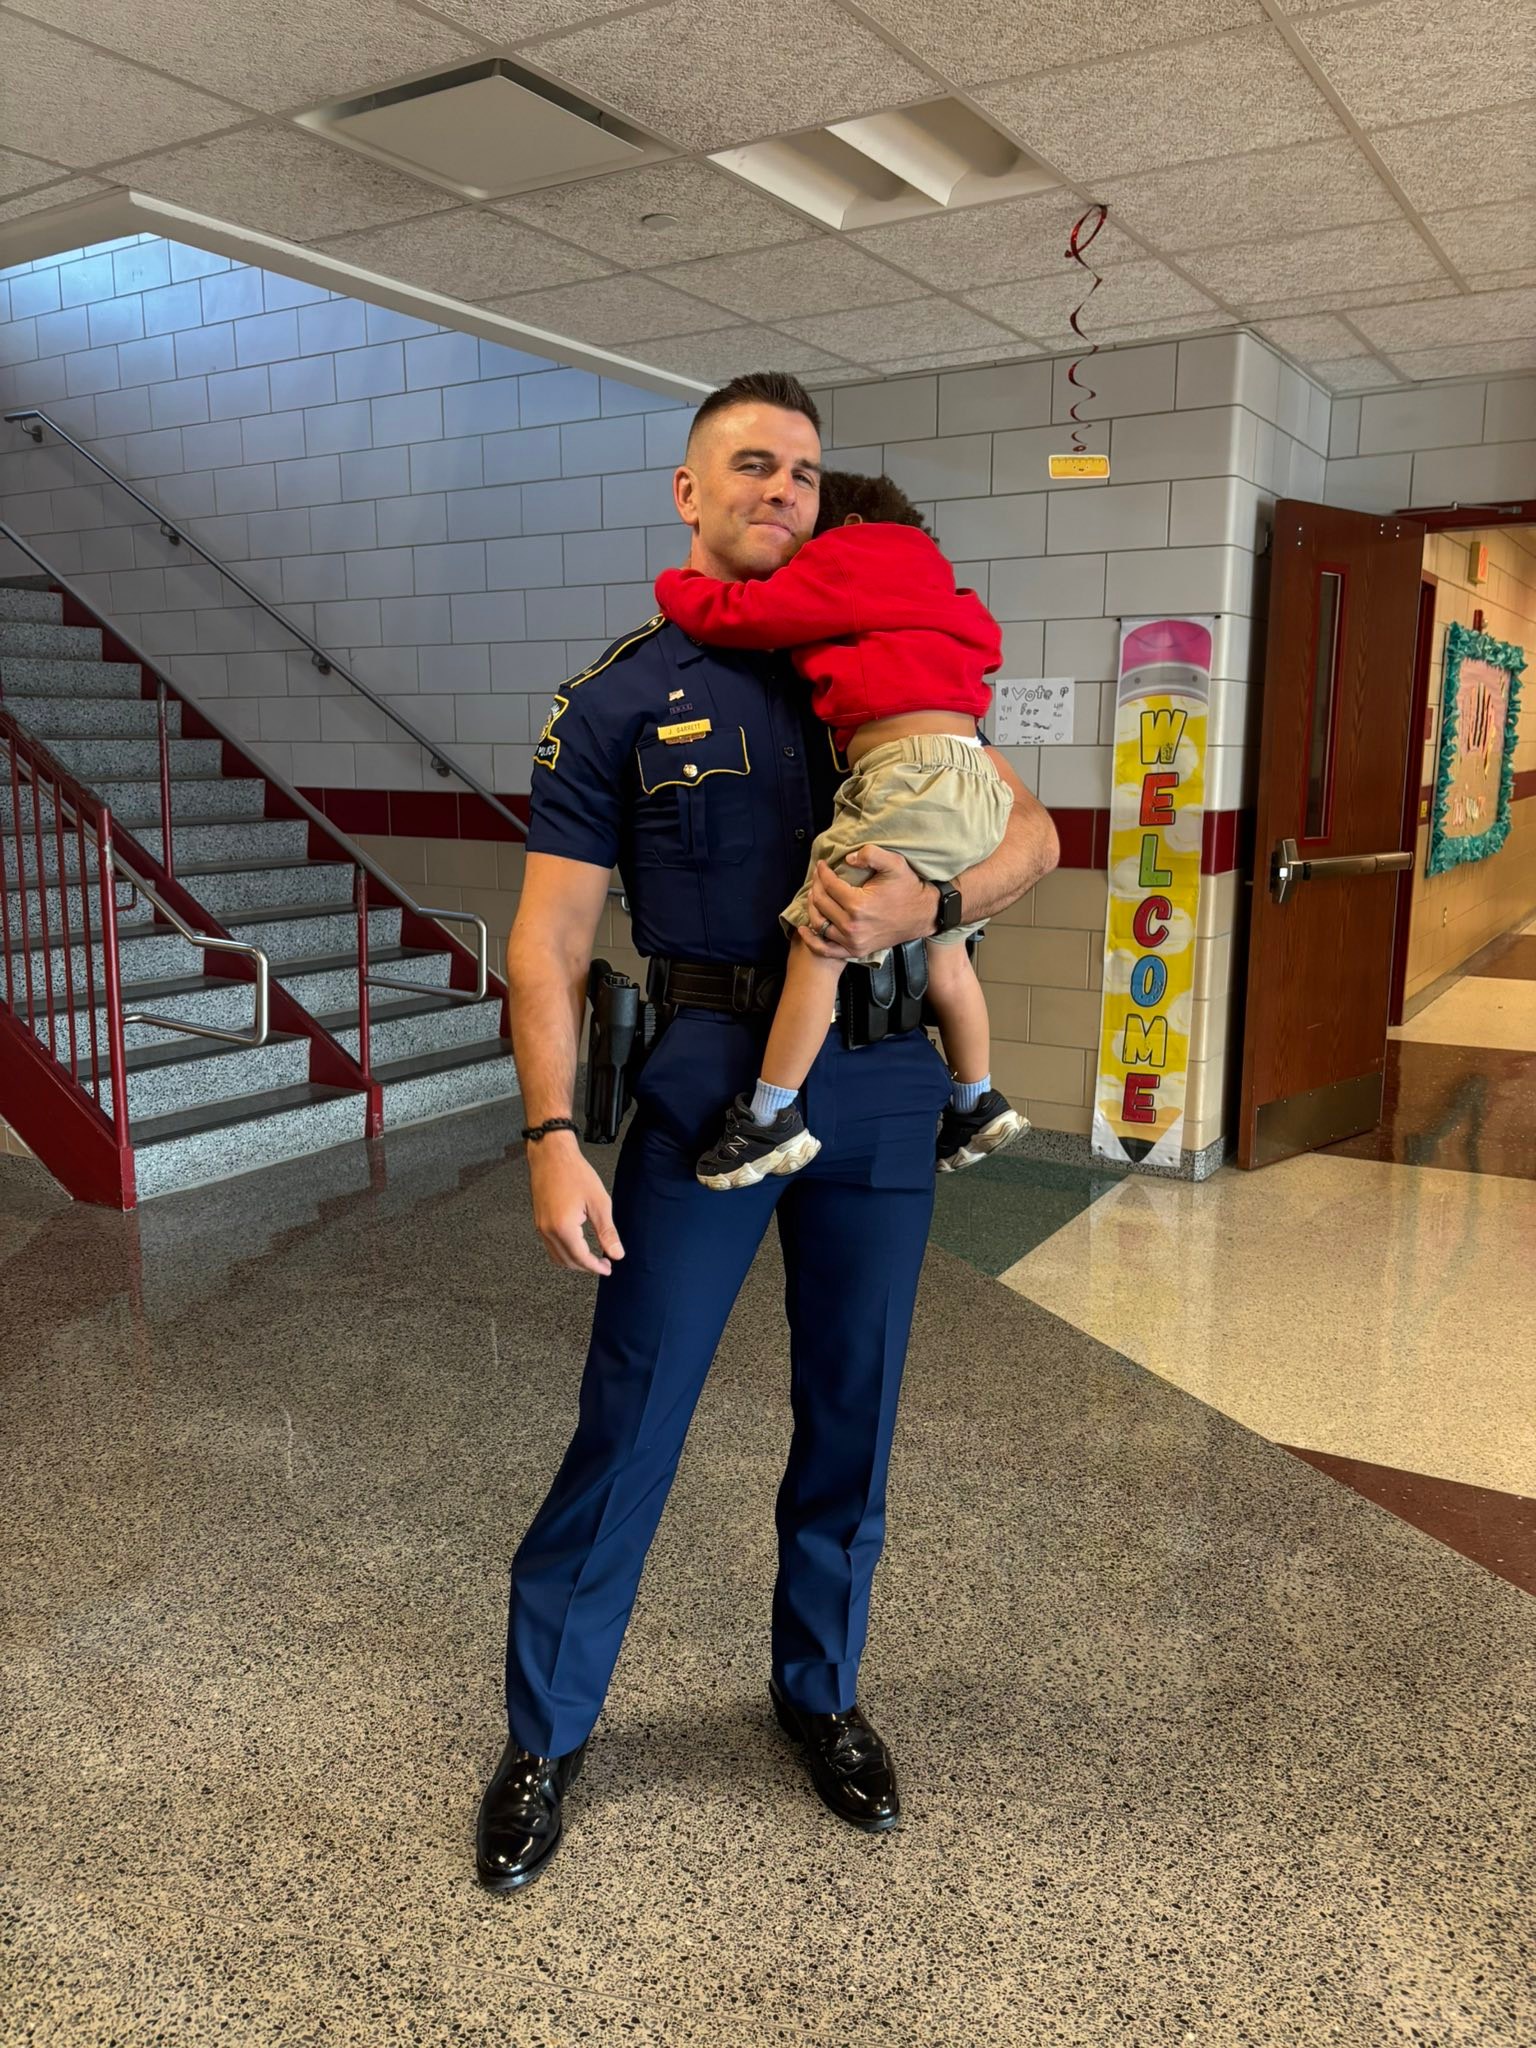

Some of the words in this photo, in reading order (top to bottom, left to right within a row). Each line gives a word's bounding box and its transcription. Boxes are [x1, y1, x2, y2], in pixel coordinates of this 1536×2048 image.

[1011, 685, 1053, 702] Vote
[537, 744, 556, 757] POLICE
[1121, 708, 1188, 1124] WELCOME
